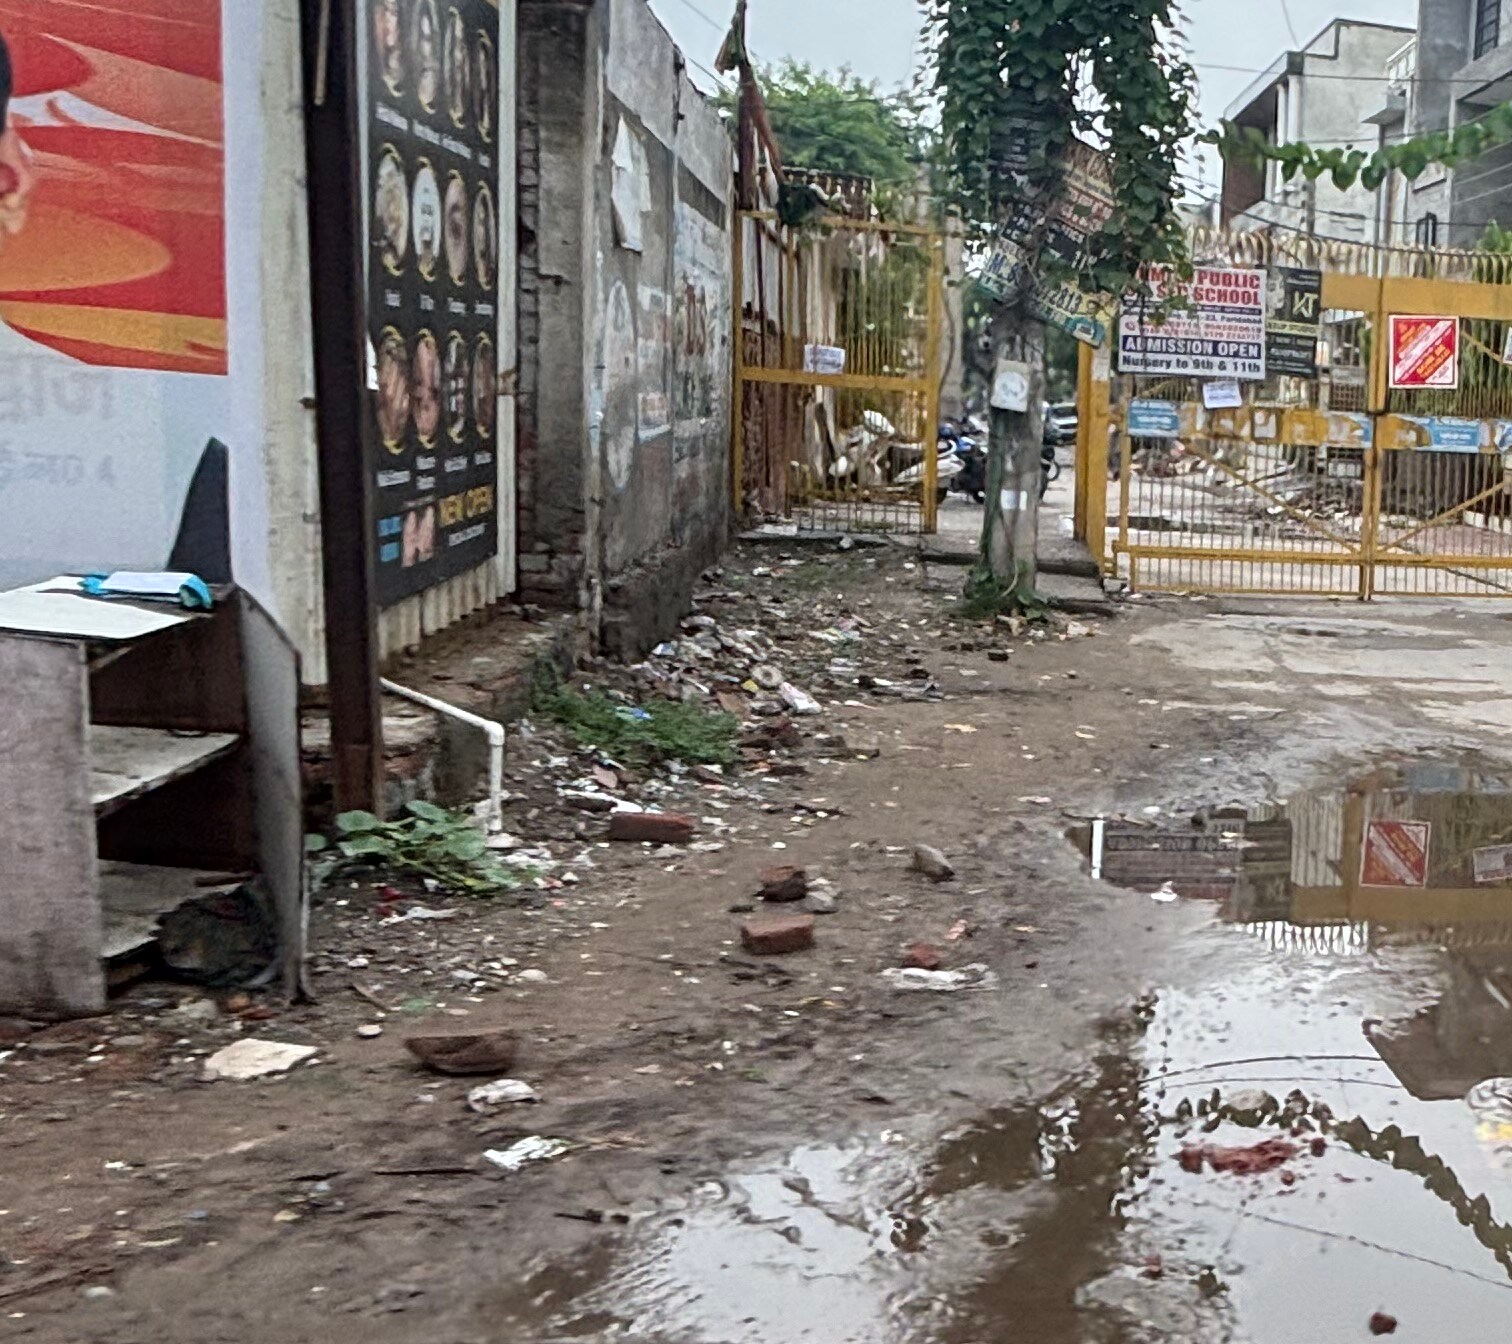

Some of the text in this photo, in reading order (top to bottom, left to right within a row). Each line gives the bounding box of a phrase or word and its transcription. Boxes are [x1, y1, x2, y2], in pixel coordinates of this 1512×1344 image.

[1196, 270, 1261, 290] PUBLIC
[1193, 287, 1262, 306] SCHOOL
[1217, 342, 1259, 358] OPEN
[1174, 358, 1188, 369] to
[1217, 360, 1227, 371] &
[1232, 361, 1261, 373] 11th
